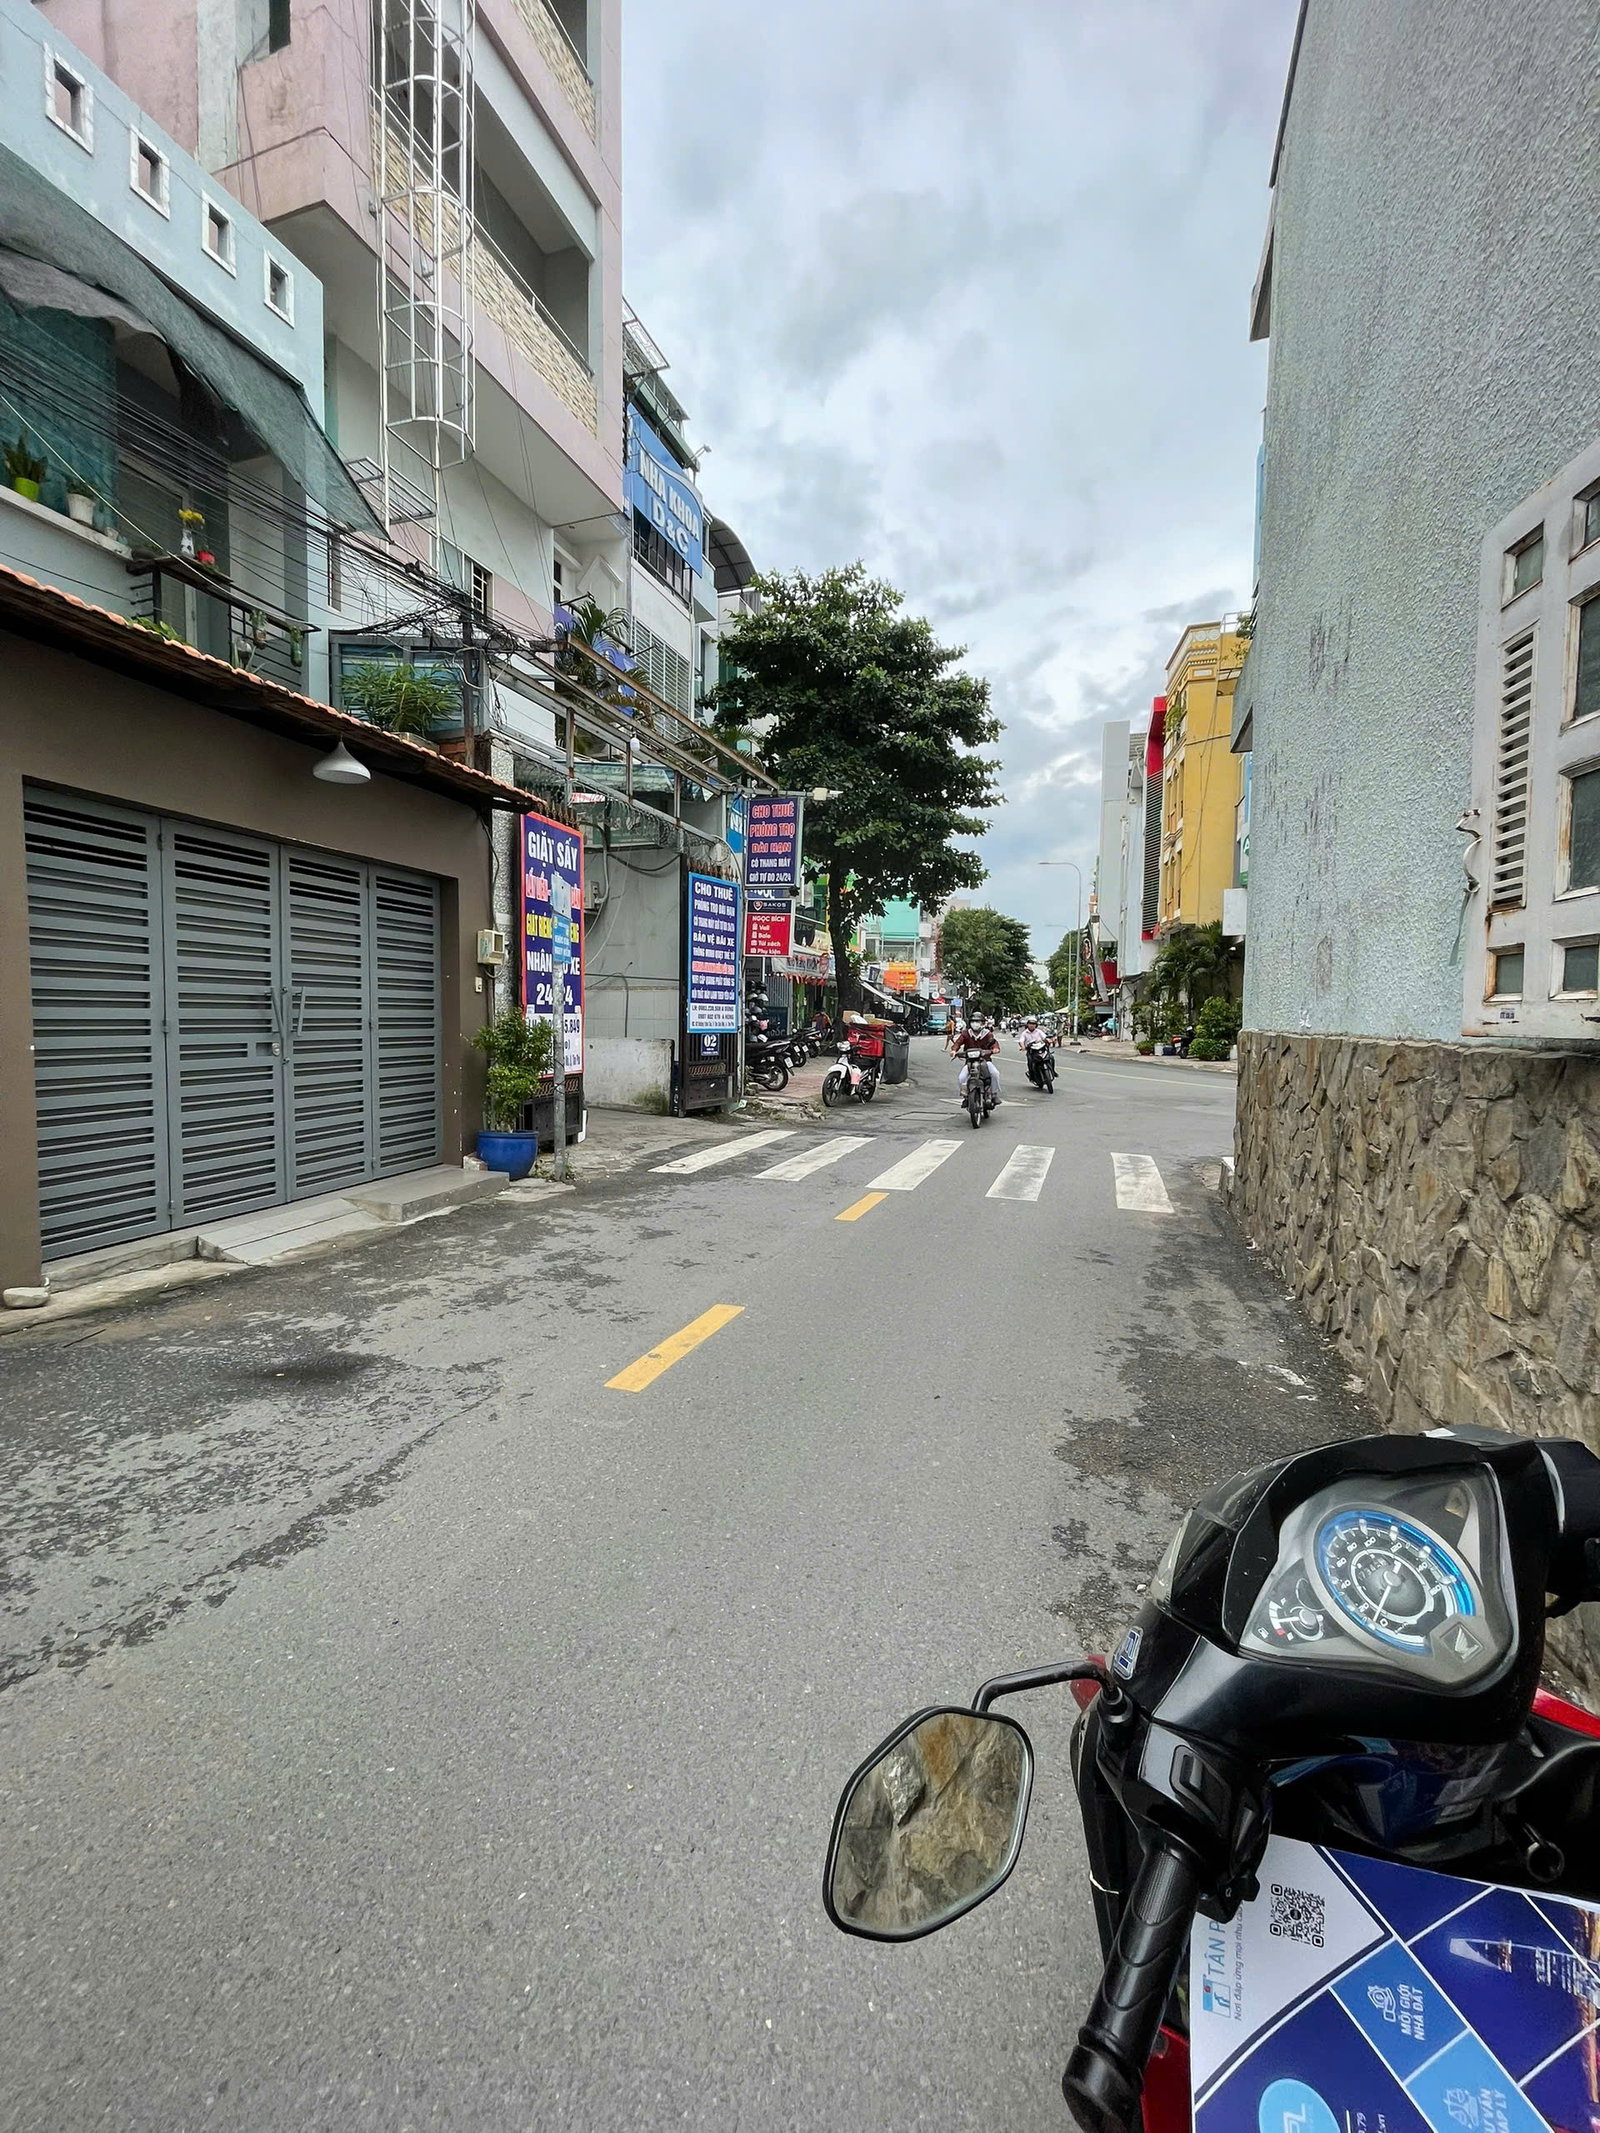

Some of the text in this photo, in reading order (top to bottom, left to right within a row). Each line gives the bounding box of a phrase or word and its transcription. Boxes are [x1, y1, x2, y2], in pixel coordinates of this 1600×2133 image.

[639, 449, 700, 542] NHA KHOA
[752, 801, 794, 818] CHO THUÊ
[750, 821, 795, 838] PHÒNG TRỌ
[528, 830, 578, 871] GIẶT SẤY
[770, 842, 791, 854] HẠN
[760, 858, 777, 867] THANG
[776, 873, 791, 882] 24/24
[694, 881, 712, 897] CHO
[713, 887, 733, 901] THUÊ
[693, 930, 706, 943] BẢO
[707, 933, 715, 945] VỆ
[727, 937, 735, 947] XE
[526, 949, 552, 976] NHẬN
[570, 957, 580, 976] XE
[703, 1034, 717, 1048] 02
[1364, 1536, 1377, 1548] 100
[1341, 1579, 1351, 1590] 40
[1358, 1602, 1370, 1613] 20
[1380, 1617, 1388, 1627] 0
[1234, 1924, 1243, 1941] nhu
[1204, 1937, 1226, 1976] TÂN
[1233, 1960, 1244, 1981] ứng
[1234, 1984, 1243, 2001] đáp
[1234, 2003, 1242, 2021] Nơi
[1397, 1983, 1412, 2036] MÔI GIỚI
